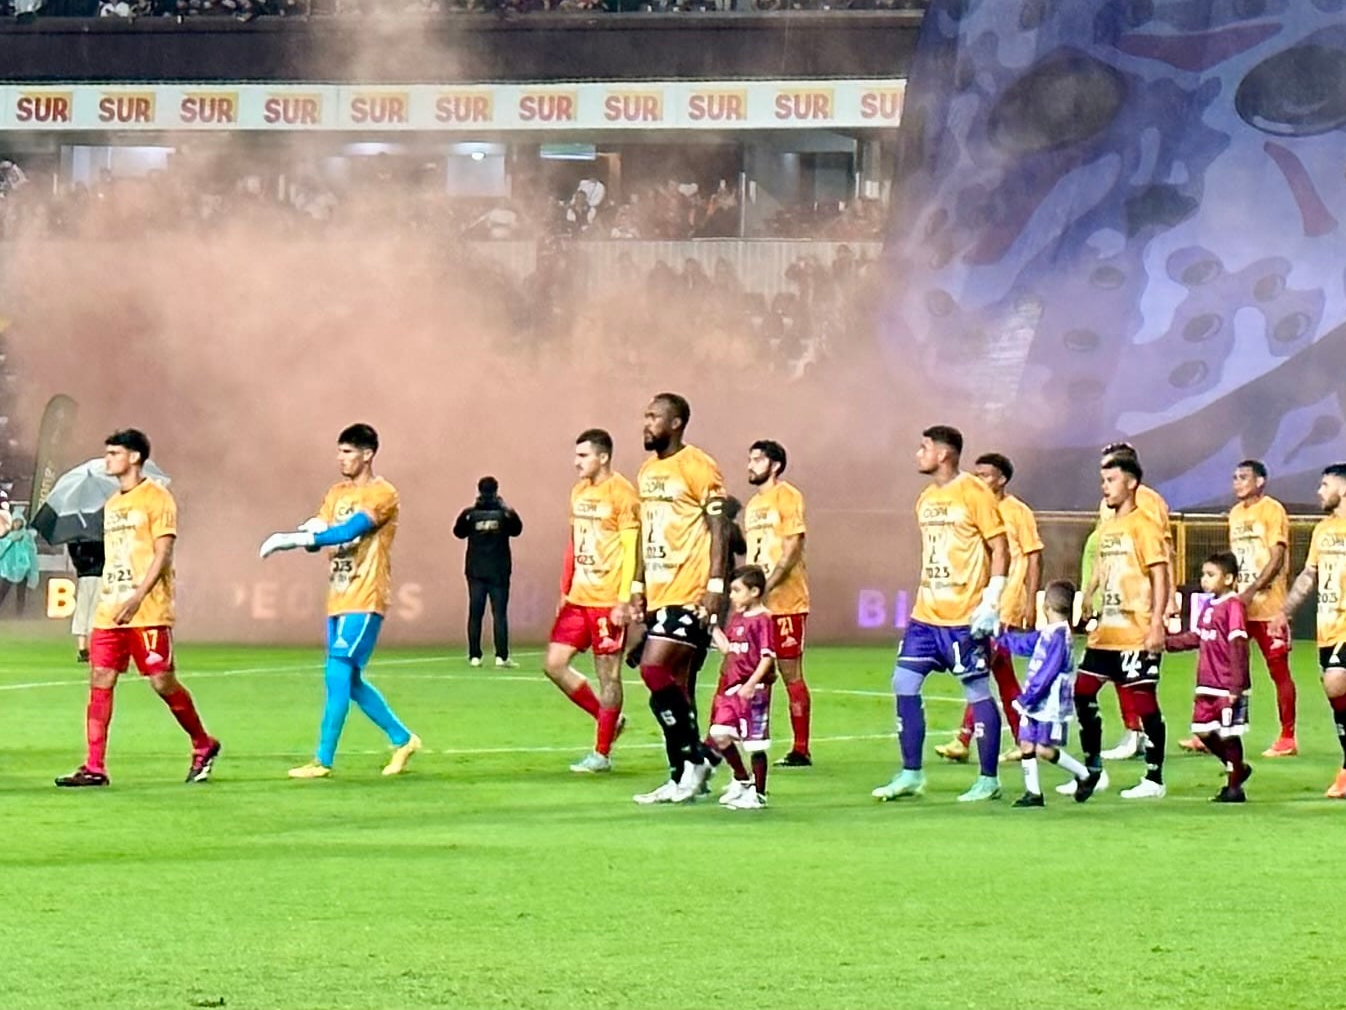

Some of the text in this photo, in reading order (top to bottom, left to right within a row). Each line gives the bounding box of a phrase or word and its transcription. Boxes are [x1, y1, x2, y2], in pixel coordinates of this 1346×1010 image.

[16, 93, 902, 124] SUR SUR SUR SUR SUR SUR SUR SUR SUR SUR SU
[777, 617, 795, 637] 21
[142, 629, 158, 652] 17
[951, 641, 961, 667] 1
